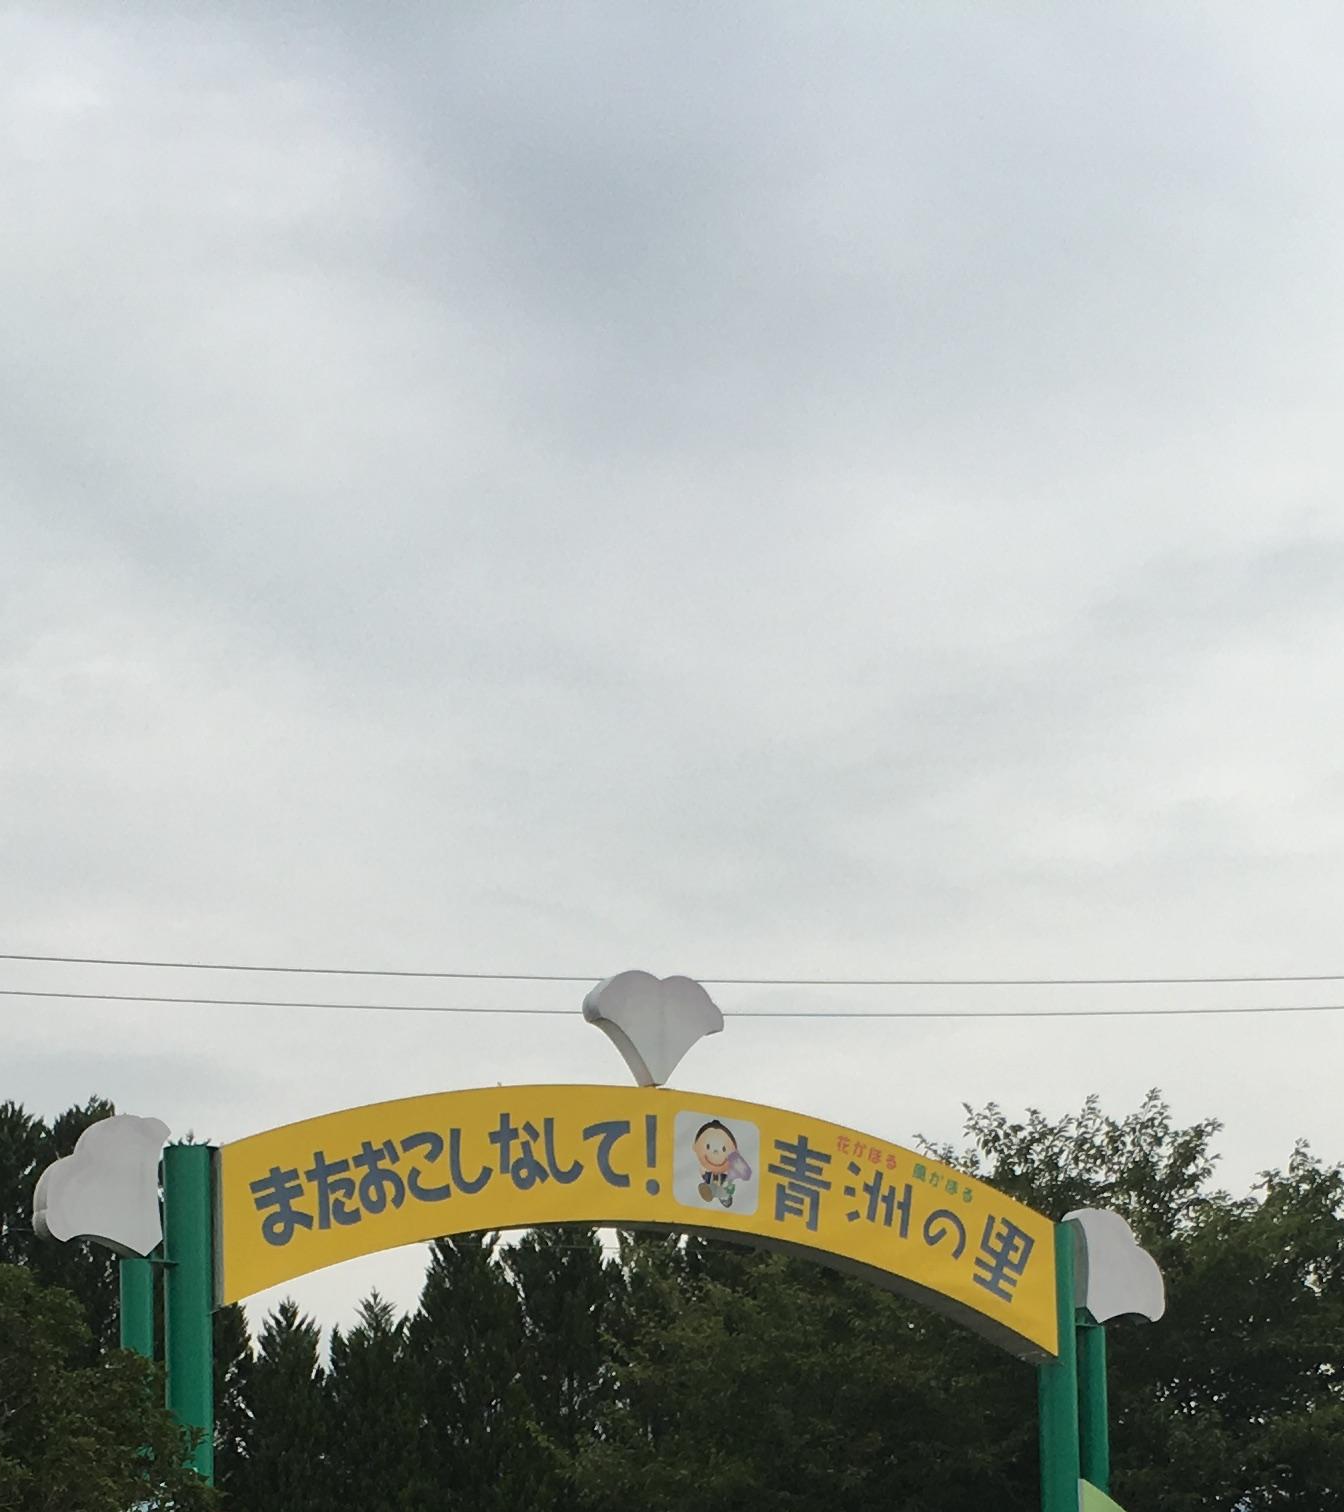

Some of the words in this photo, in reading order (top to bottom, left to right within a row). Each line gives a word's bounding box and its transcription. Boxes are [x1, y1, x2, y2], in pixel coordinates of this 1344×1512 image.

[249, 1112, 661, 1247] またおこしなして!
[768, 1135, 1035, 1303] 青洲の里
